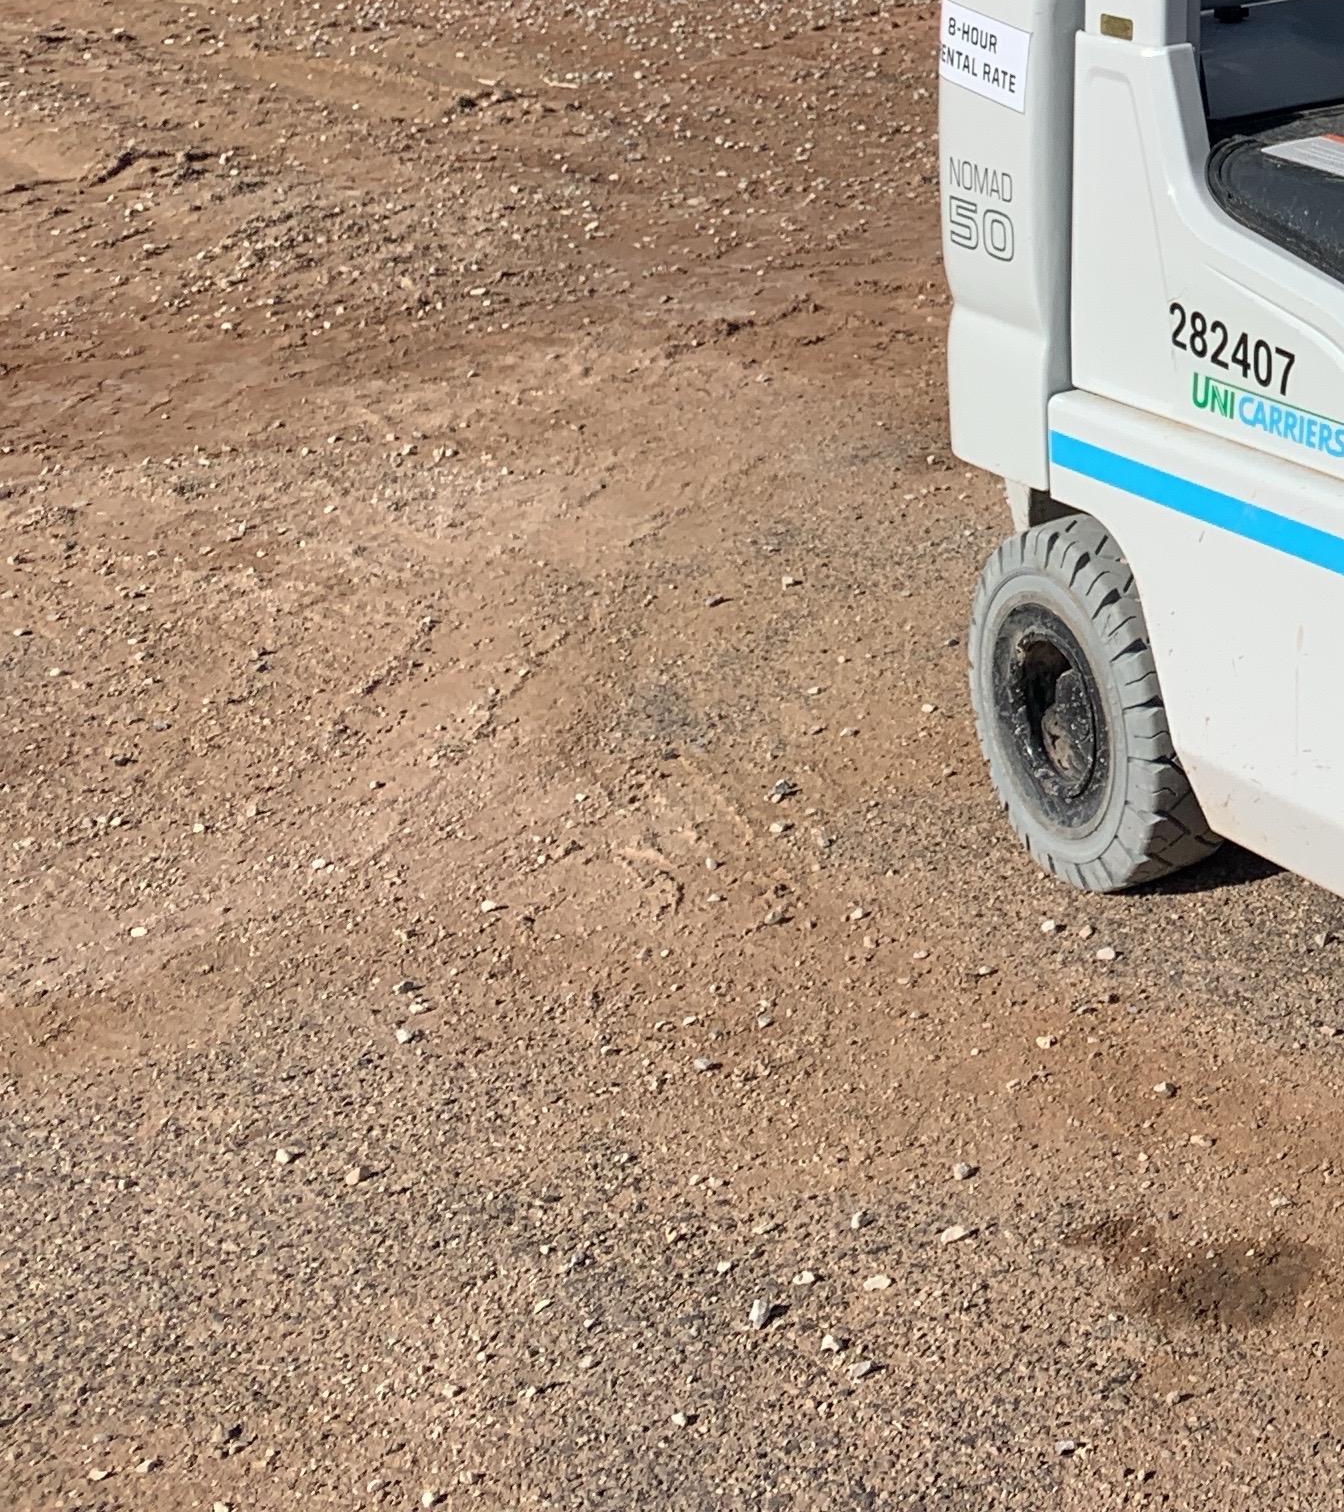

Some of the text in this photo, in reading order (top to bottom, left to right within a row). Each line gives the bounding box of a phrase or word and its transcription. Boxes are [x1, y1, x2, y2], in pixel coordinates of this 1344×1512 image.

[948, 17, 997, 55] 8-HOUR
[940, 44, 1016, 94] ENTAL RATE
[950, 156, 1013, 203] NOMAD
[950, 195, 1014, 262] 50
[1169, 302, 1296, 396] 282407
